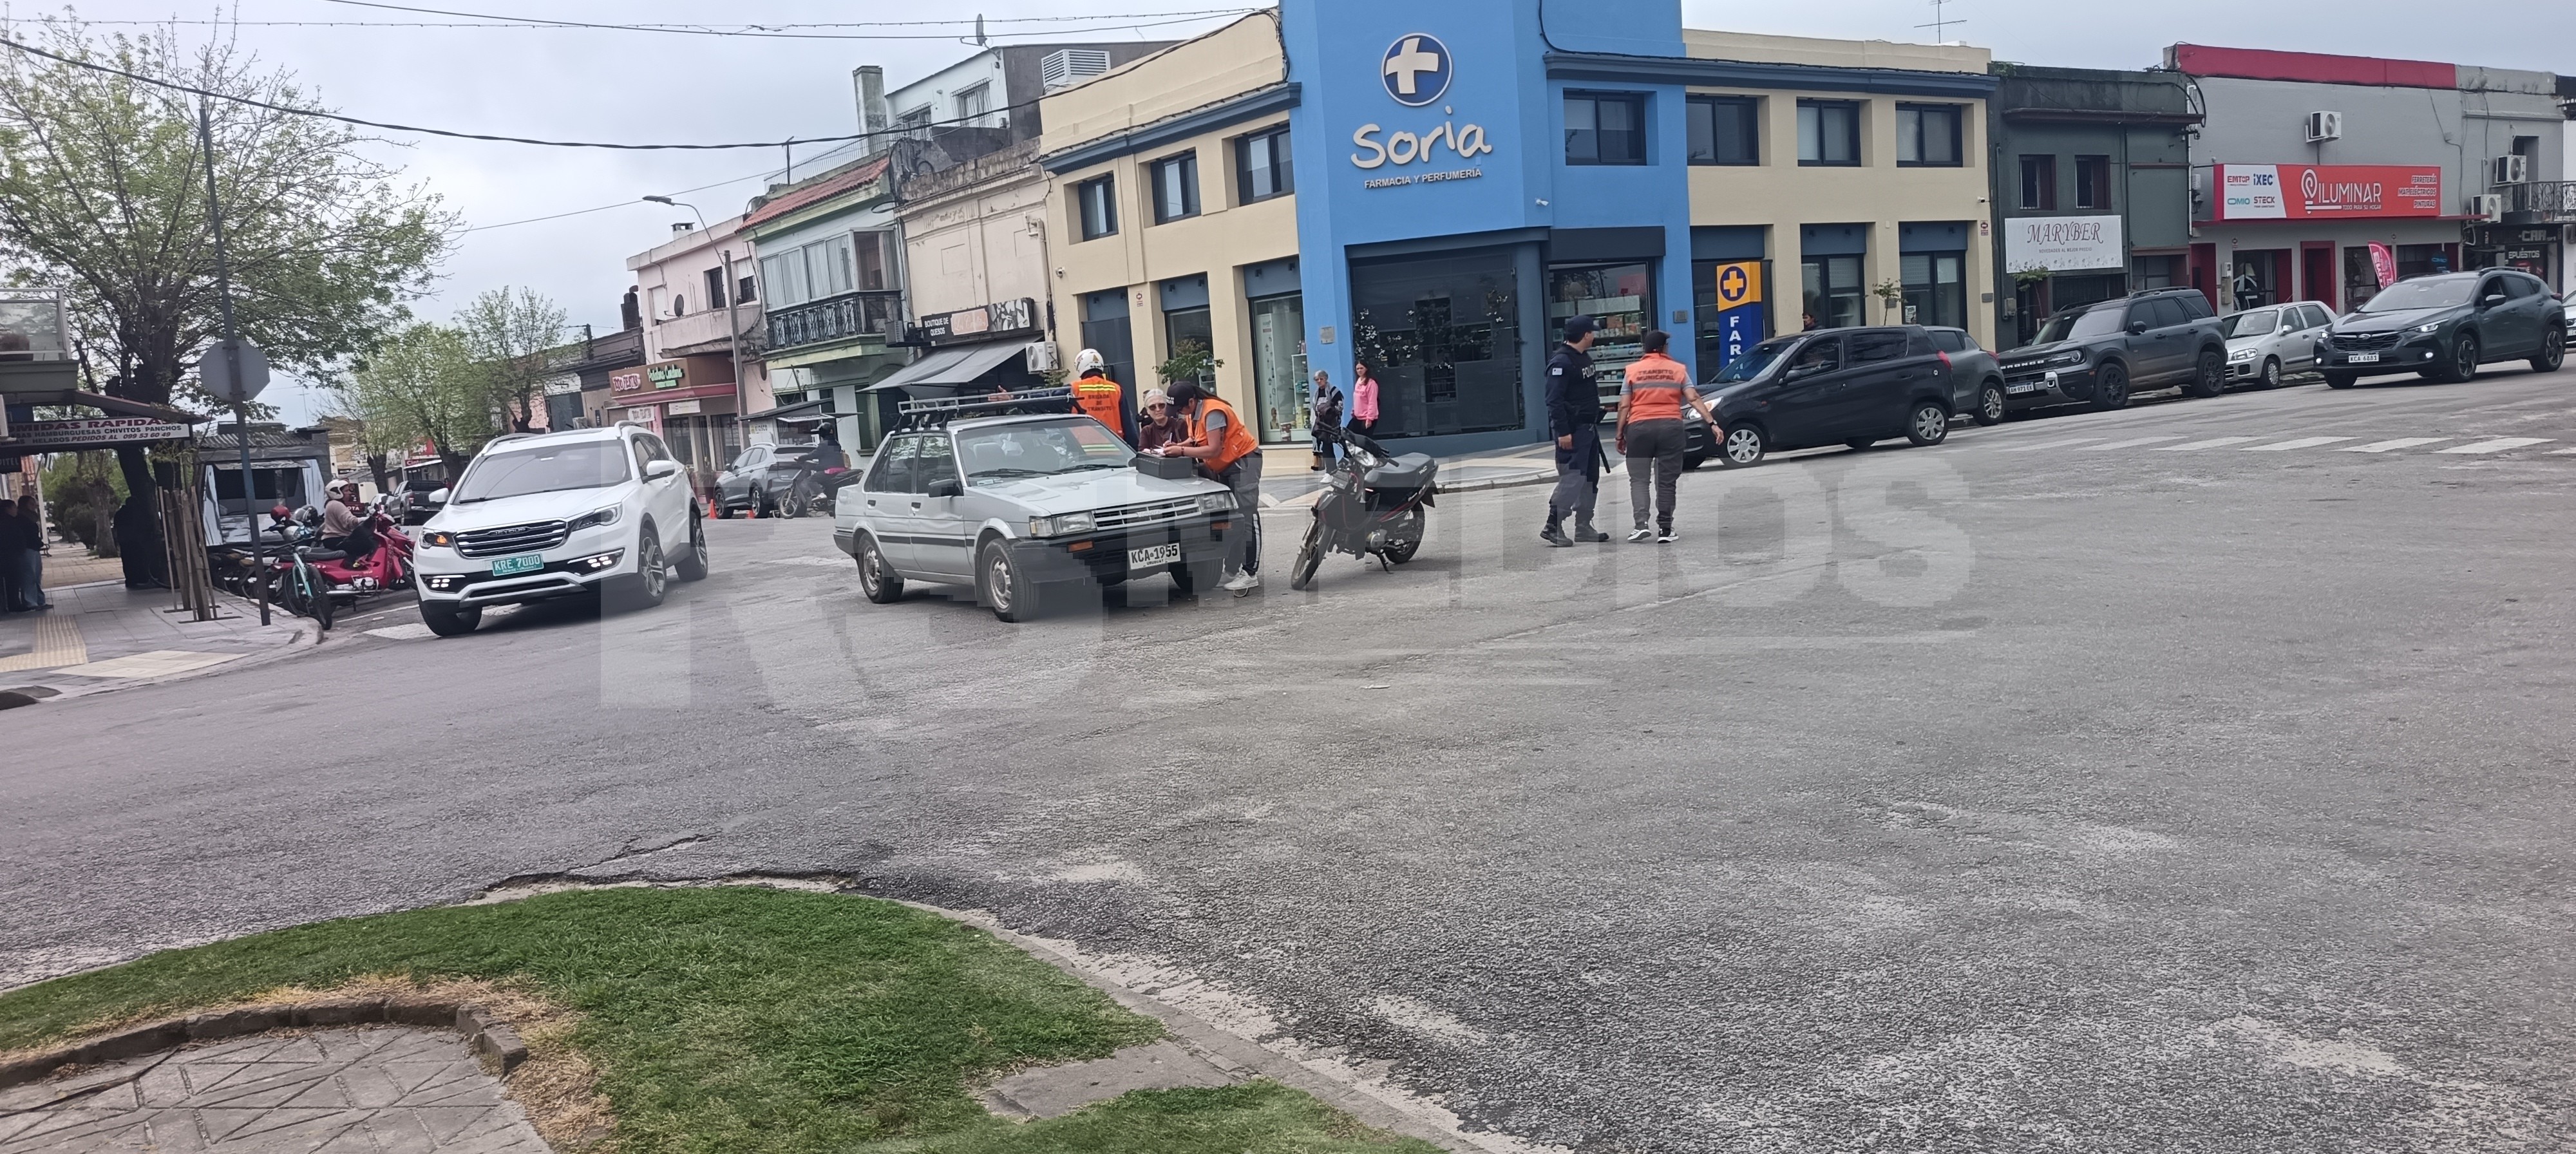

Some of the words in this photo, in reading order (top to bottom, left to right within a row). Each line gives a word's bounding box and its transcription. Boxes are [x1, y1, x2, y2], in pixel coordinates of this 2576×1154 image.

[1351, 106, 1492, 169] Soria
[1364, 176, 1411, 189] FARMACIA
[1414, 175, 1419, 184] Y
[1422, 167, 1482, 183] PERFUMERÍA
[2253, 173, 2273, 185] iXEC
[2318, 183, 2382, 203] ILUMINAR
[2414, 200, 2436, 208] PINTURAS
[2027, 222, 2103, 245] MARYBER
[924, 318, 943, 328] BOUTIQUE
[930, 327, 945, 336] QUESOS
[8, 422, 81, 433] OMIDAS
[35, 429, 101, 437] HAMBURGUESAS
[1131, 549, 1150, 563] KCA
[1153, 545, 1177, 559] 1955
[494, 559, 513, 571] KRE
[516, 555, 540, 567] 7000
